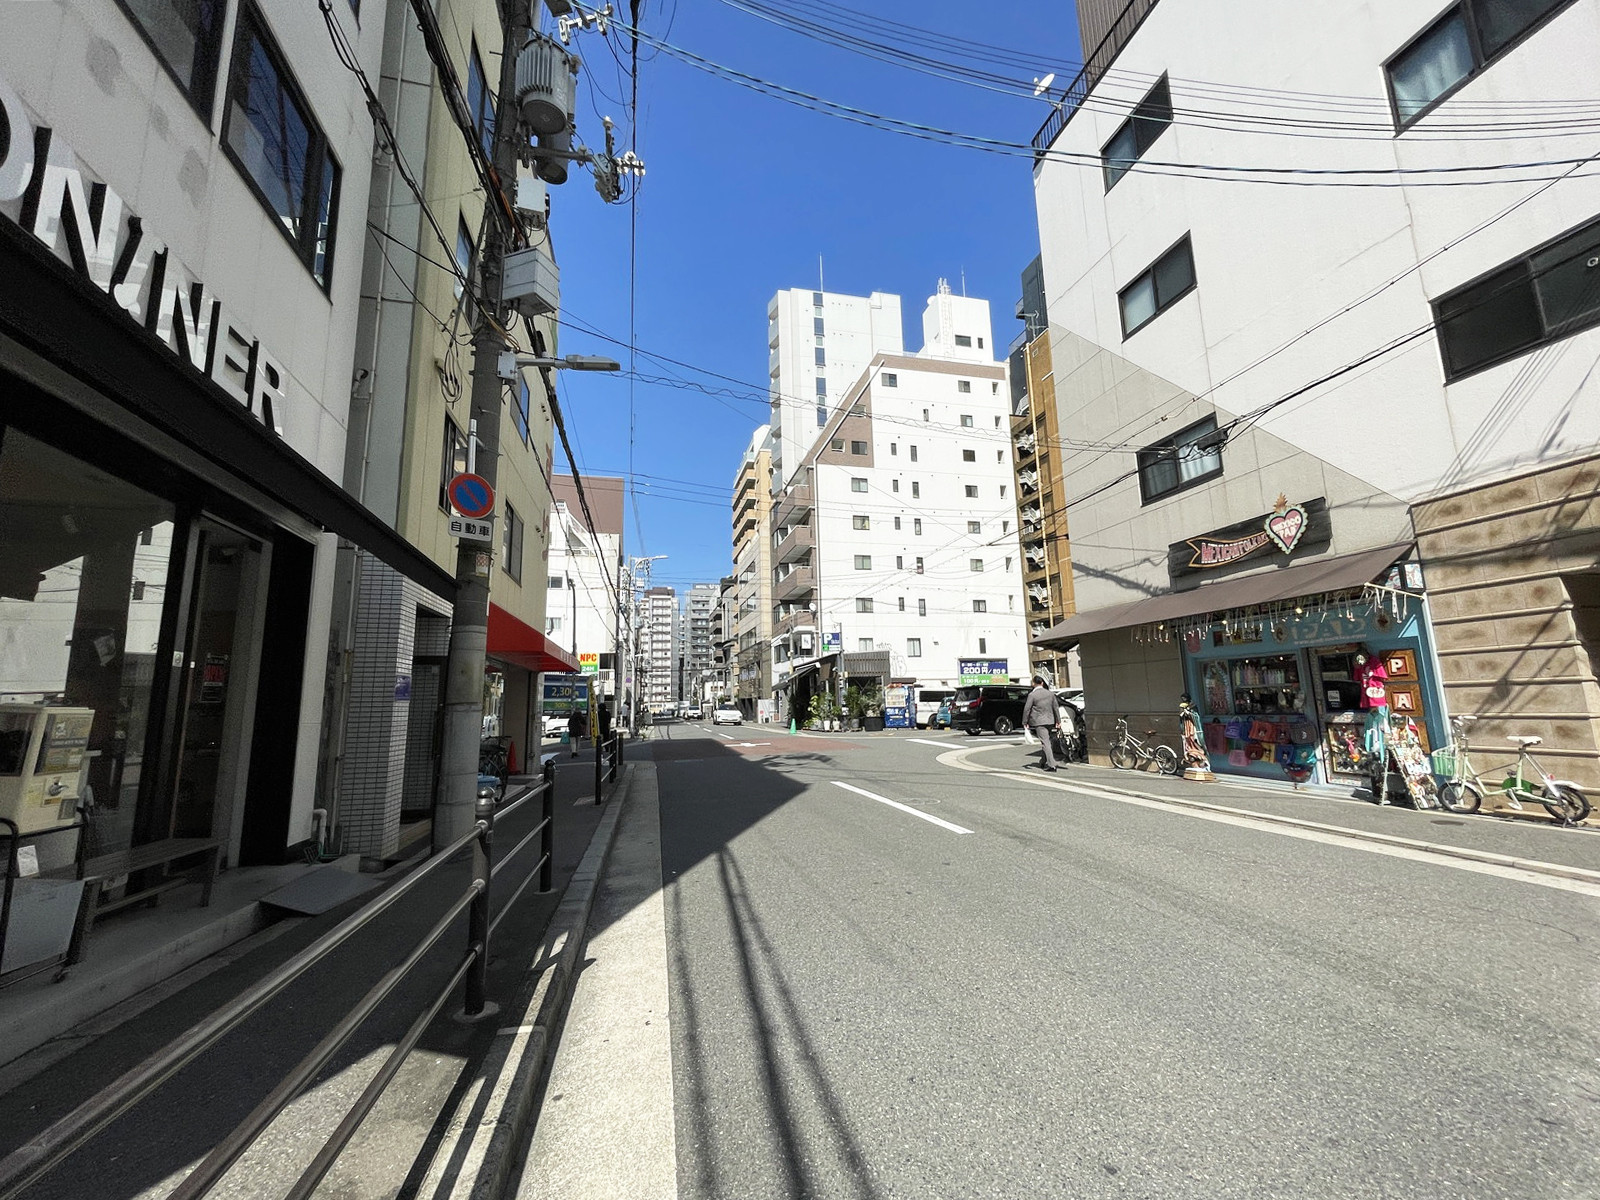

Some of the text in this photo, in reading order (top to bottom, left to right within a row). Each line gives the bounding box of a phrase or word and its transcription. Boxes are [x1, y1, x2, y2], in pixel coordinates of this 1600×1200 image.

[451, 521, 490, 537] 自動車
[1238, 537, 1257, 554] FOLK
[580, 653, 597, 662] NPC
[1390, 658, 1403, 673] P
[1397, 693, 1410, 708] A
